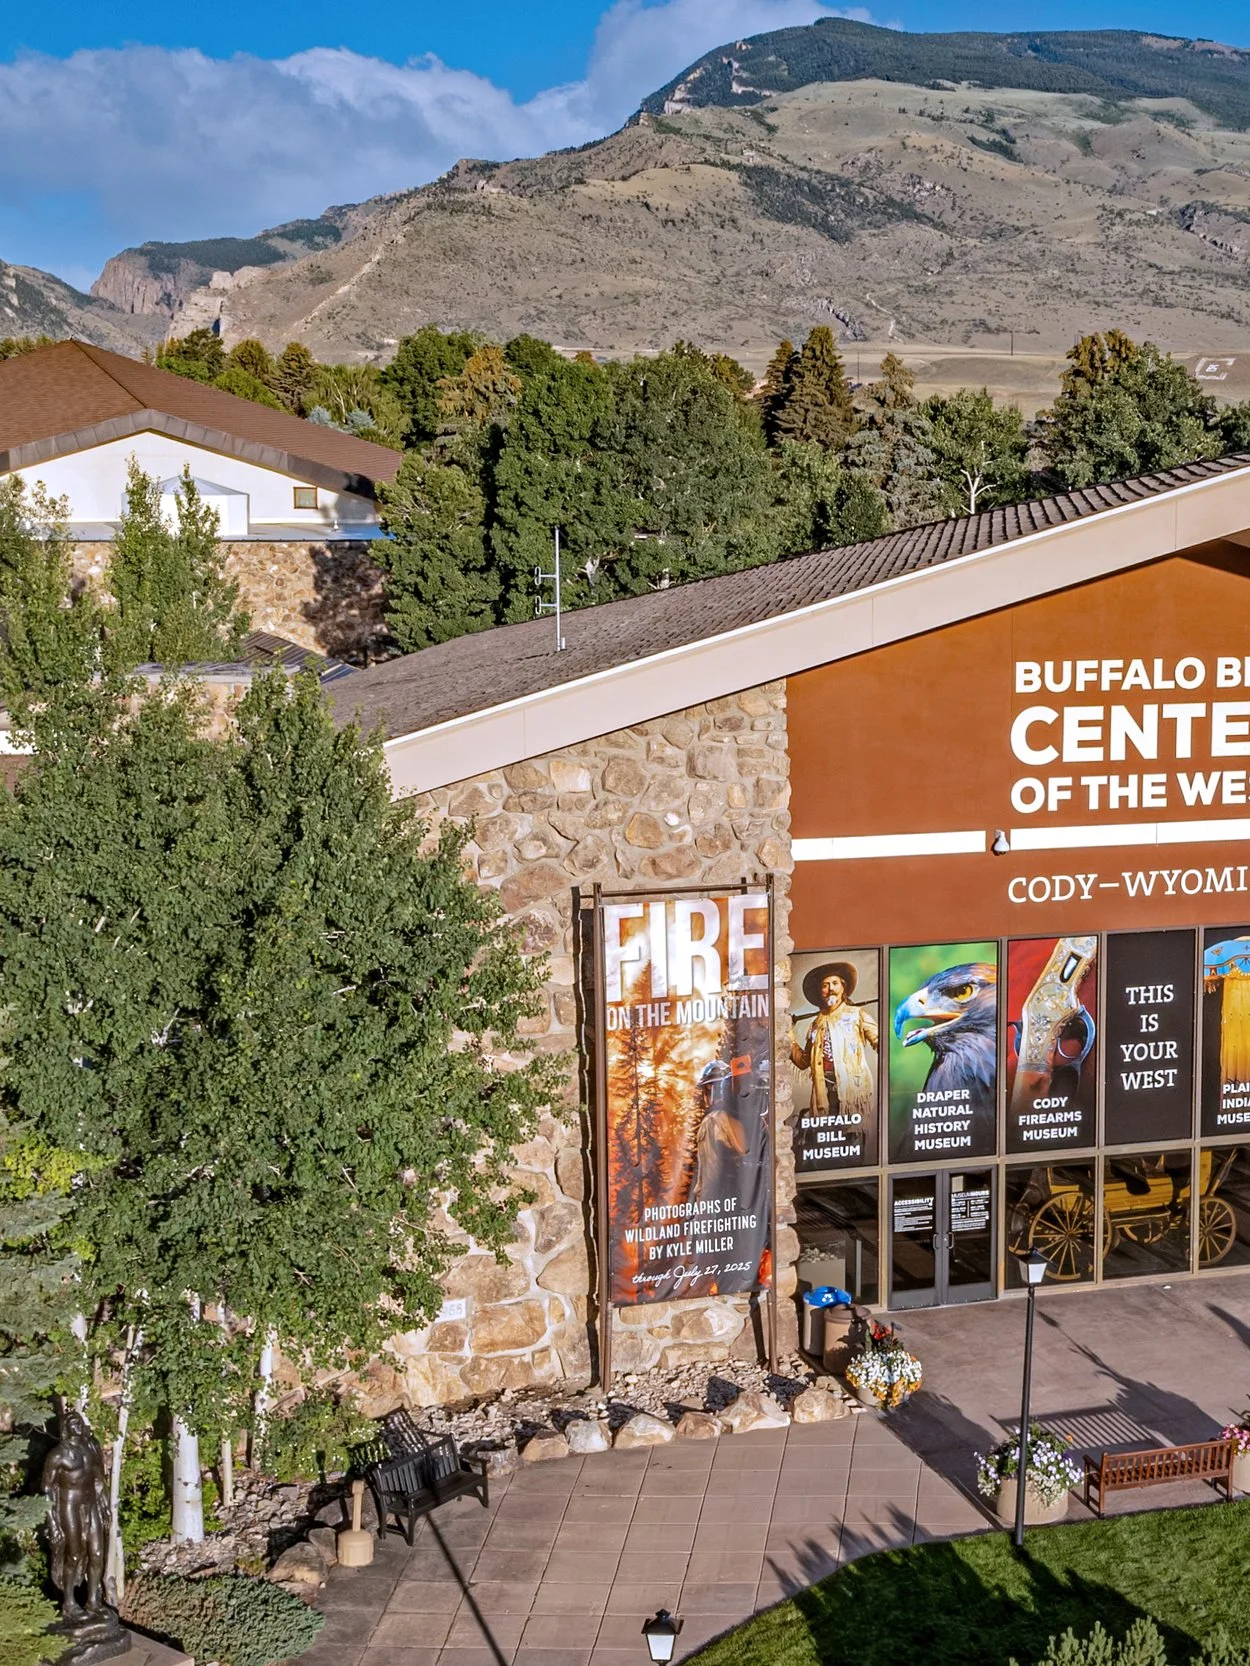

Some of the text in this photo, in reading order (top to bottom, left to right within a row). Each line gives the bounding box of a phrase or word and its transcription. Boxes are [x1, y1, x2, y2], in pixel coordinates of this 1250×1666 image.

[1015, 656, 1206, 693] BUFFALO
[1010, 776, 1073, 814] OF
[1080, 773, 1168, 810] THE
[605, 894, 769, 1003] FIRE
[1125, 983, 1174, 1006] THIS
[606, 993, 769, 1031] ON THE MOUNTAIN
[1140, 1014, 1159, 1033] IS
[1120, 1041, 1178, 1063] YOUR
[1121, 1069, 1178, 1091] WEST
[916, 1088, 970, 1104] DRAPER
[1033, 1096, 1068, 1110] CODY
[801, 1112, 862, 1129] BUFFALO
[912, 1104, 973, 1119] NATURAL
[1018, 1110, 1082, 1126] FIREARMS
[816, 1130, 846, 1143] BILL
[914, 1119, 971, 1136] HISTORY
[1022, 1126, 1078, 1141] MUSEUM
[802, 1144, 861, 1161] MUSEUM
[914, 1135, 971, 1151] MUSEUM
[644, 1197, 738, 1222] PHOTOGRAPHS OF
[894, 1197, 934, 1205] ACCESSIBILITY
[625, 1214, 757, 1243] WILDLAND FIREFIGHTING
[649, 1236, 734, 1260] BY KYLE MILLER
[632, 1261, 753, 1289] through July 27, 2025
